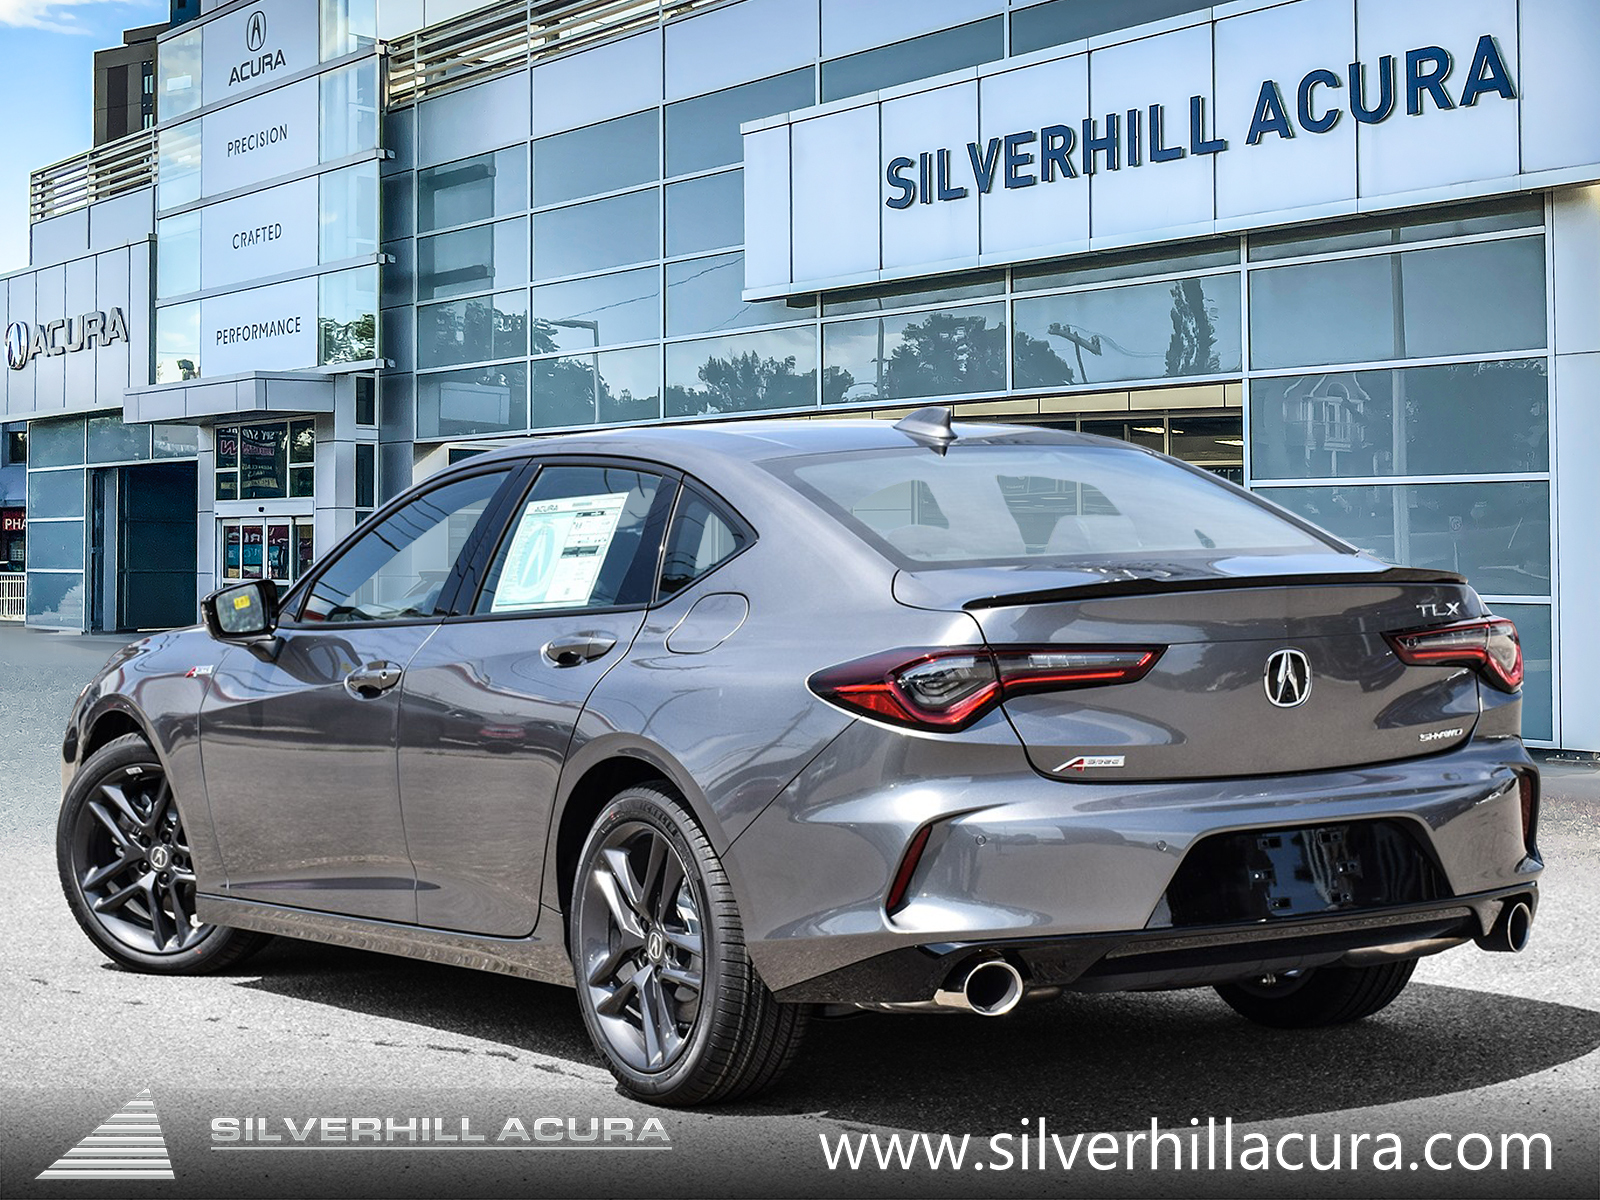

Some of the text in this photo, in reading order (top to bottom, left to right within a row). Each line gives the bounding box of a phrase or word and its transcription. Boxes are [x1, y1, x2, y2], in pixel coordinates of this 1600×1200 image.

[228, 49, 286, 87] ACURA
[885, 34, 1518, 210] SILVERHILL ACURA
[227, 123, 288, 157] PRECISION
[232, 223, 282, 250] CRAFTED
[27, 306, 128, 359] ACURA
[216, 316, 301, 346] PERFORMANCE
[534, 504, 559, 513] ACURA
[1416, 602, 1459, 618] TLX
